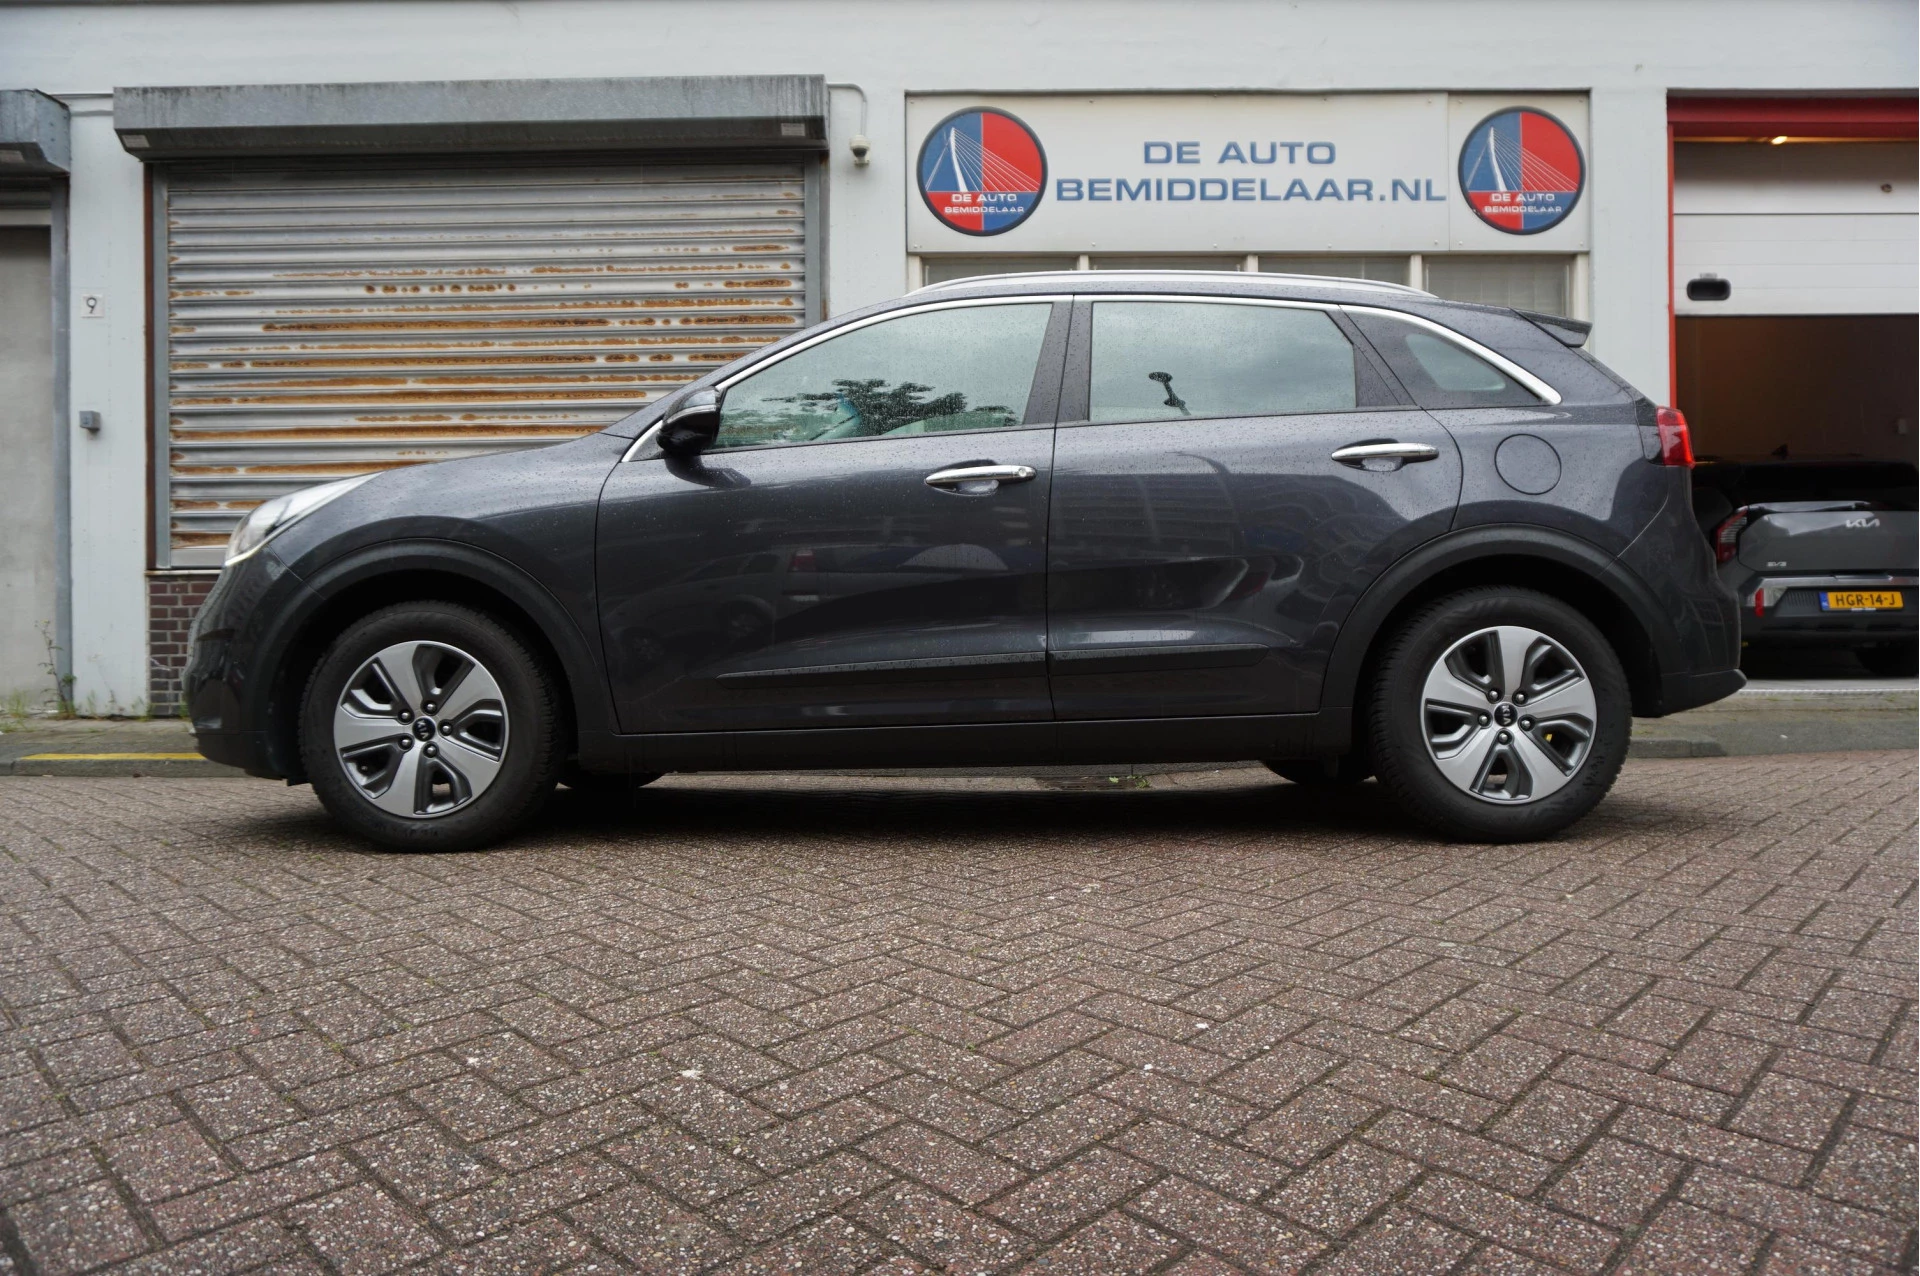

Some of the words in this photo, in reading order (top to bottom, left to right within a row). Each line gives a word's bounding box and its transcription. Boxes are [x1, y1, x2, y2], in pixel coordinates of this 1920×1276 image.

[1143, 141, 1201, 164] DE
[1217, 141, 1337, 165] AUTO
[1056, 177, 1447, 202] BEMIDDELAAR.NL
[951, 193, 974, 202] DE
[976, 193, 1018, 202] AUTO
[1491, 193, 1512, 202] DE
[1515, 193, 1555, 202] AUTO
[944, 206, 1025, 214] BEMIDDELAAR
[1484, 205, 1562, 213] BEMIDDELAAR
[86, 297, 97, 314] 9
[1846, 518, 1880, 528] KIA
[1835, 593, 1896, 606] HGR-14-J
